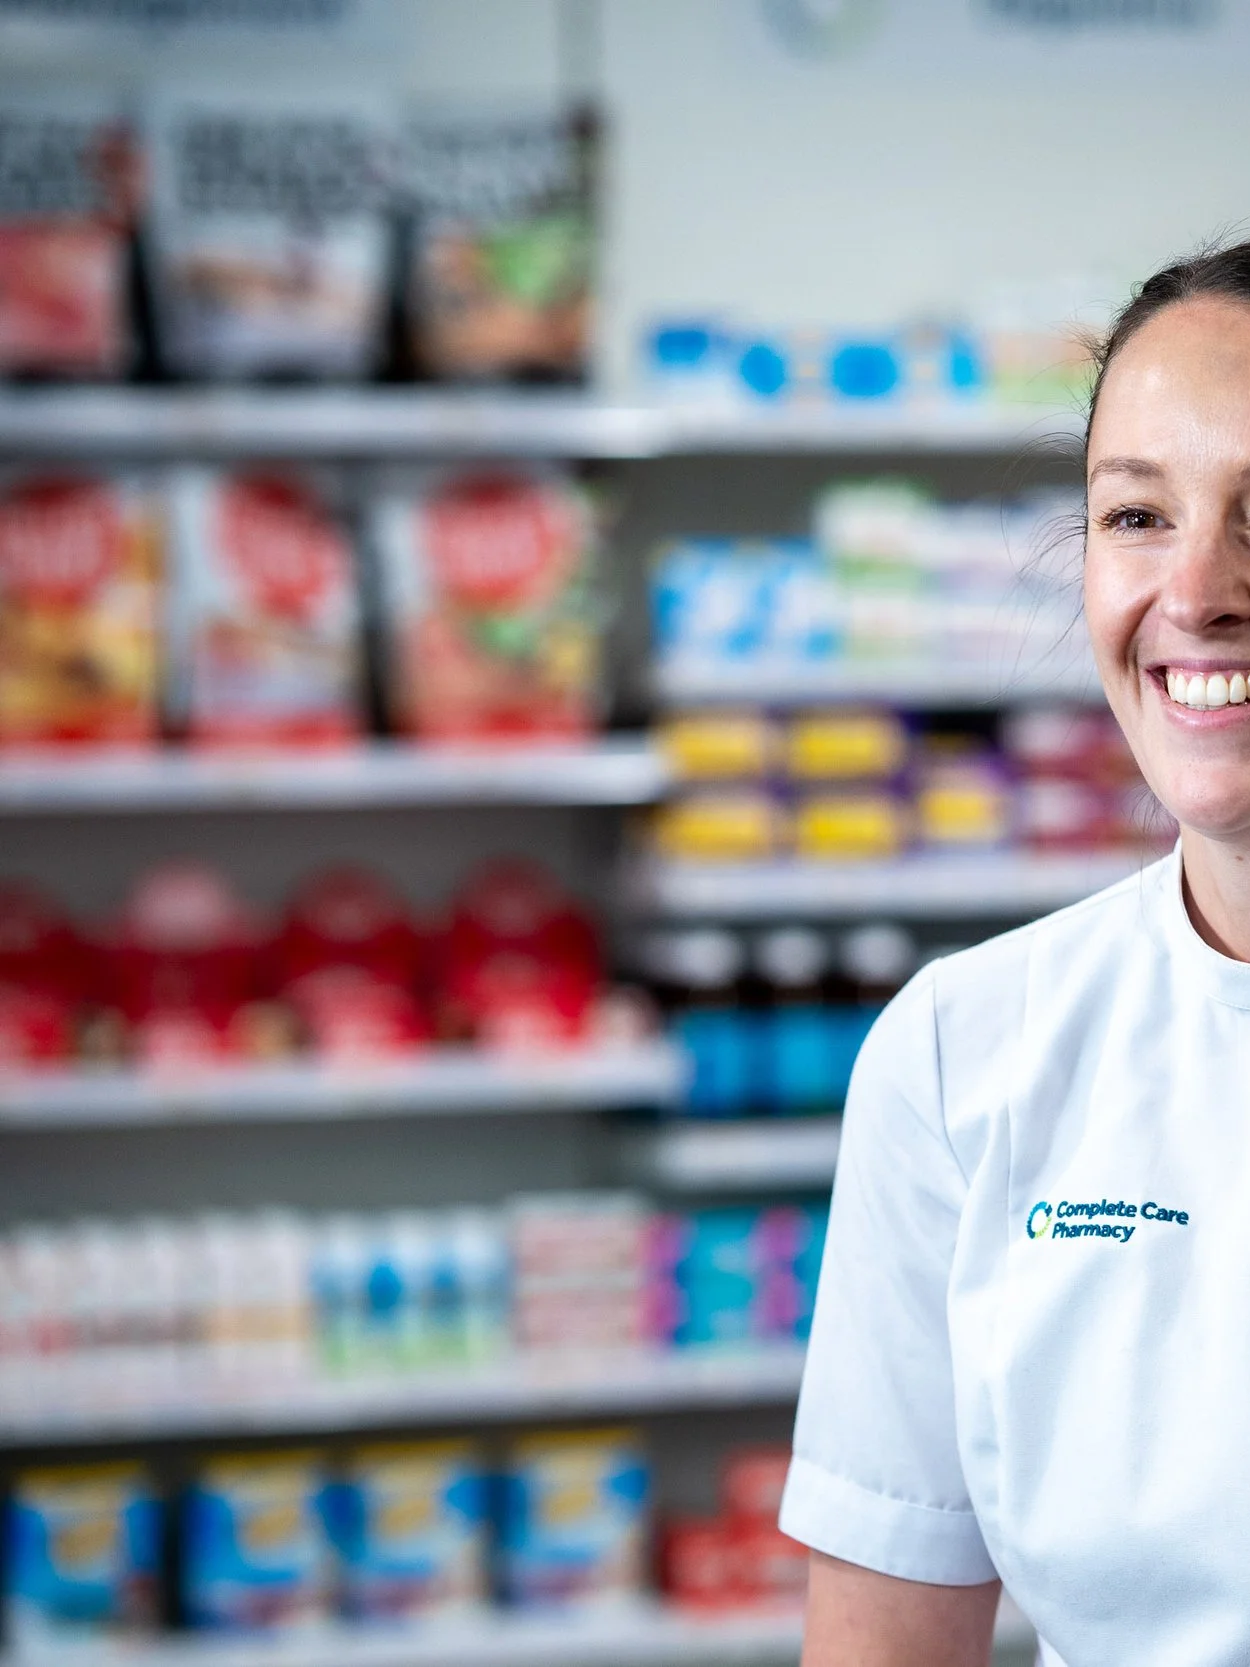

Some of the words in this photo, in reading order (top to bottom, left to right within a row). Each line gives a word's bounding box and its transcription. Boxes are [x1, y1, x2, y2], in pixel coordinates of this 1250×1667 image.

[1057, 1199, 1137, 1219] Complete
[1140, 1202, 1189, 1225] Care
[1052, 1222, 1136, 1243] Pharmacy
